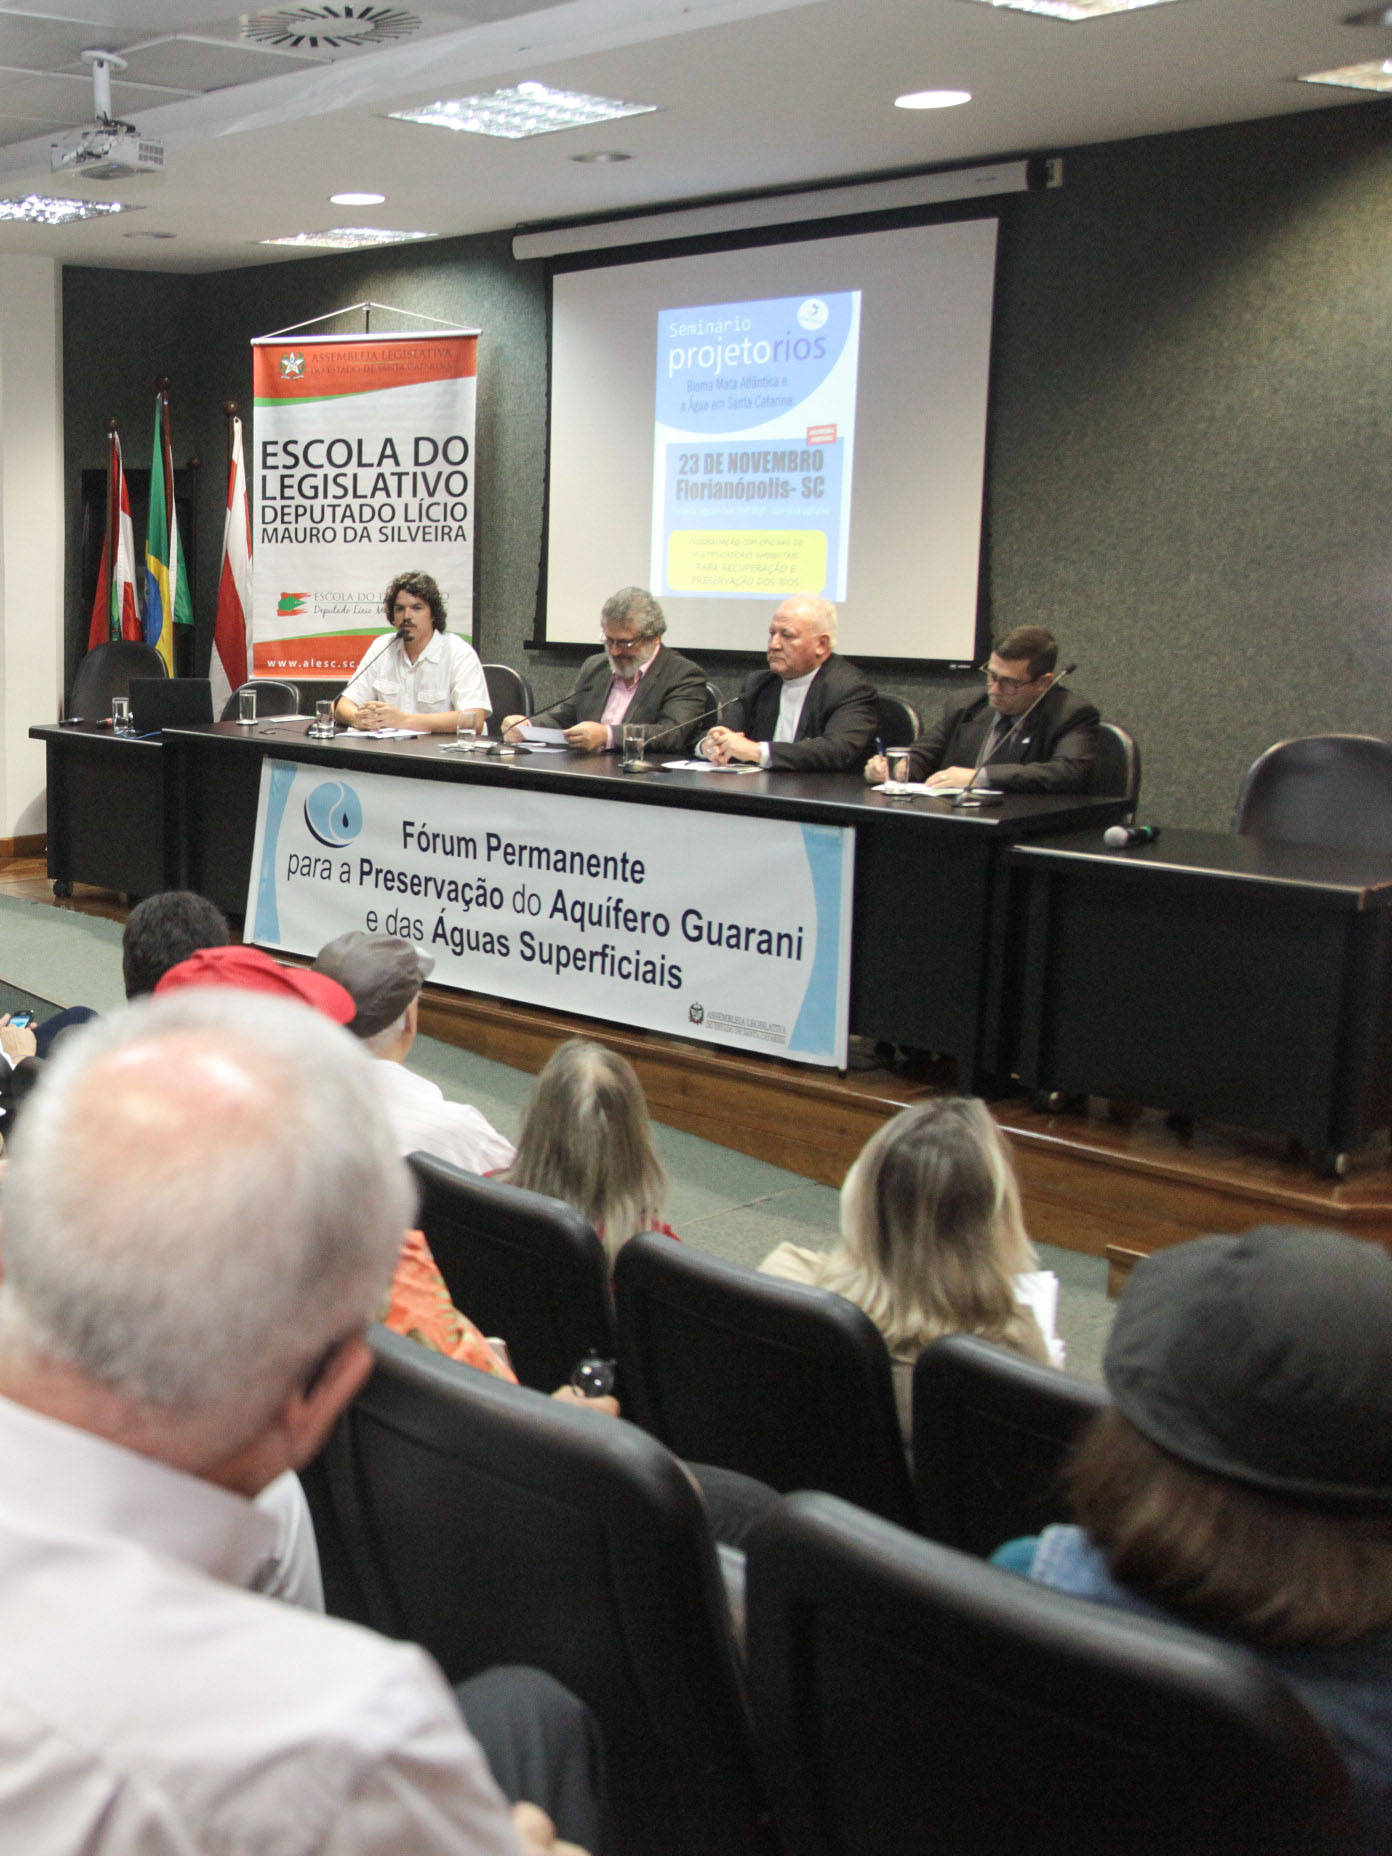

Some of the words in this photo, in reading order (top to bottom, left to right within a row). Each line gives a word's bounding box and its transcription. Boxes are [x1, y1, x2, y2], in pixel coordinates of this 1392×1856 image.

[669, 315, 752, 339] Seminário
[311, 351, 378, 362] ASSEMBLEIA
[381, 348, 453, 360] LEGISLATIVA
[261, 437, 401, 470] ESCOLA
[413, 435, 469, 467] DO
[678, 453, 700, 475] 23
[704, 452, 724, 474] DE
[728, 449, 824, 474] NOVEMBRO
[261, 470, 469, 500] LEGISLATIVO
[801, 476, 825, 499] SC
[261, 503, 396, 525] DEPUTADO
[404, 498, 468, 523] LÍCIO
[261, 526, 337, 544] MAURO
[343, 526, 372, 543] DA
[378, 525, 467, 543] SILVEIRA
[314, 592, 353, 602] ESCOLA
[358, 592, 375, 601] DO
[314, 605, 350, 619] Deputado
[402, 820, 477, 860] Fórum
[486, 832, 645, 884] Permanente
[287, 853, 332, 881] para
[339, 861, 351, 884] a
[359, 857, 504, 912] Preservação
[512, 883, 541, 916] do
[549, 889, 670, 937] Aquífero
[681, 908, 803, 961] Guarani
[366, 909, 378, 932] e
[385, 907, 424, 941] das
[432, 907, 511, 957] Águas
[519, 930, 683, 990] Superficiais
